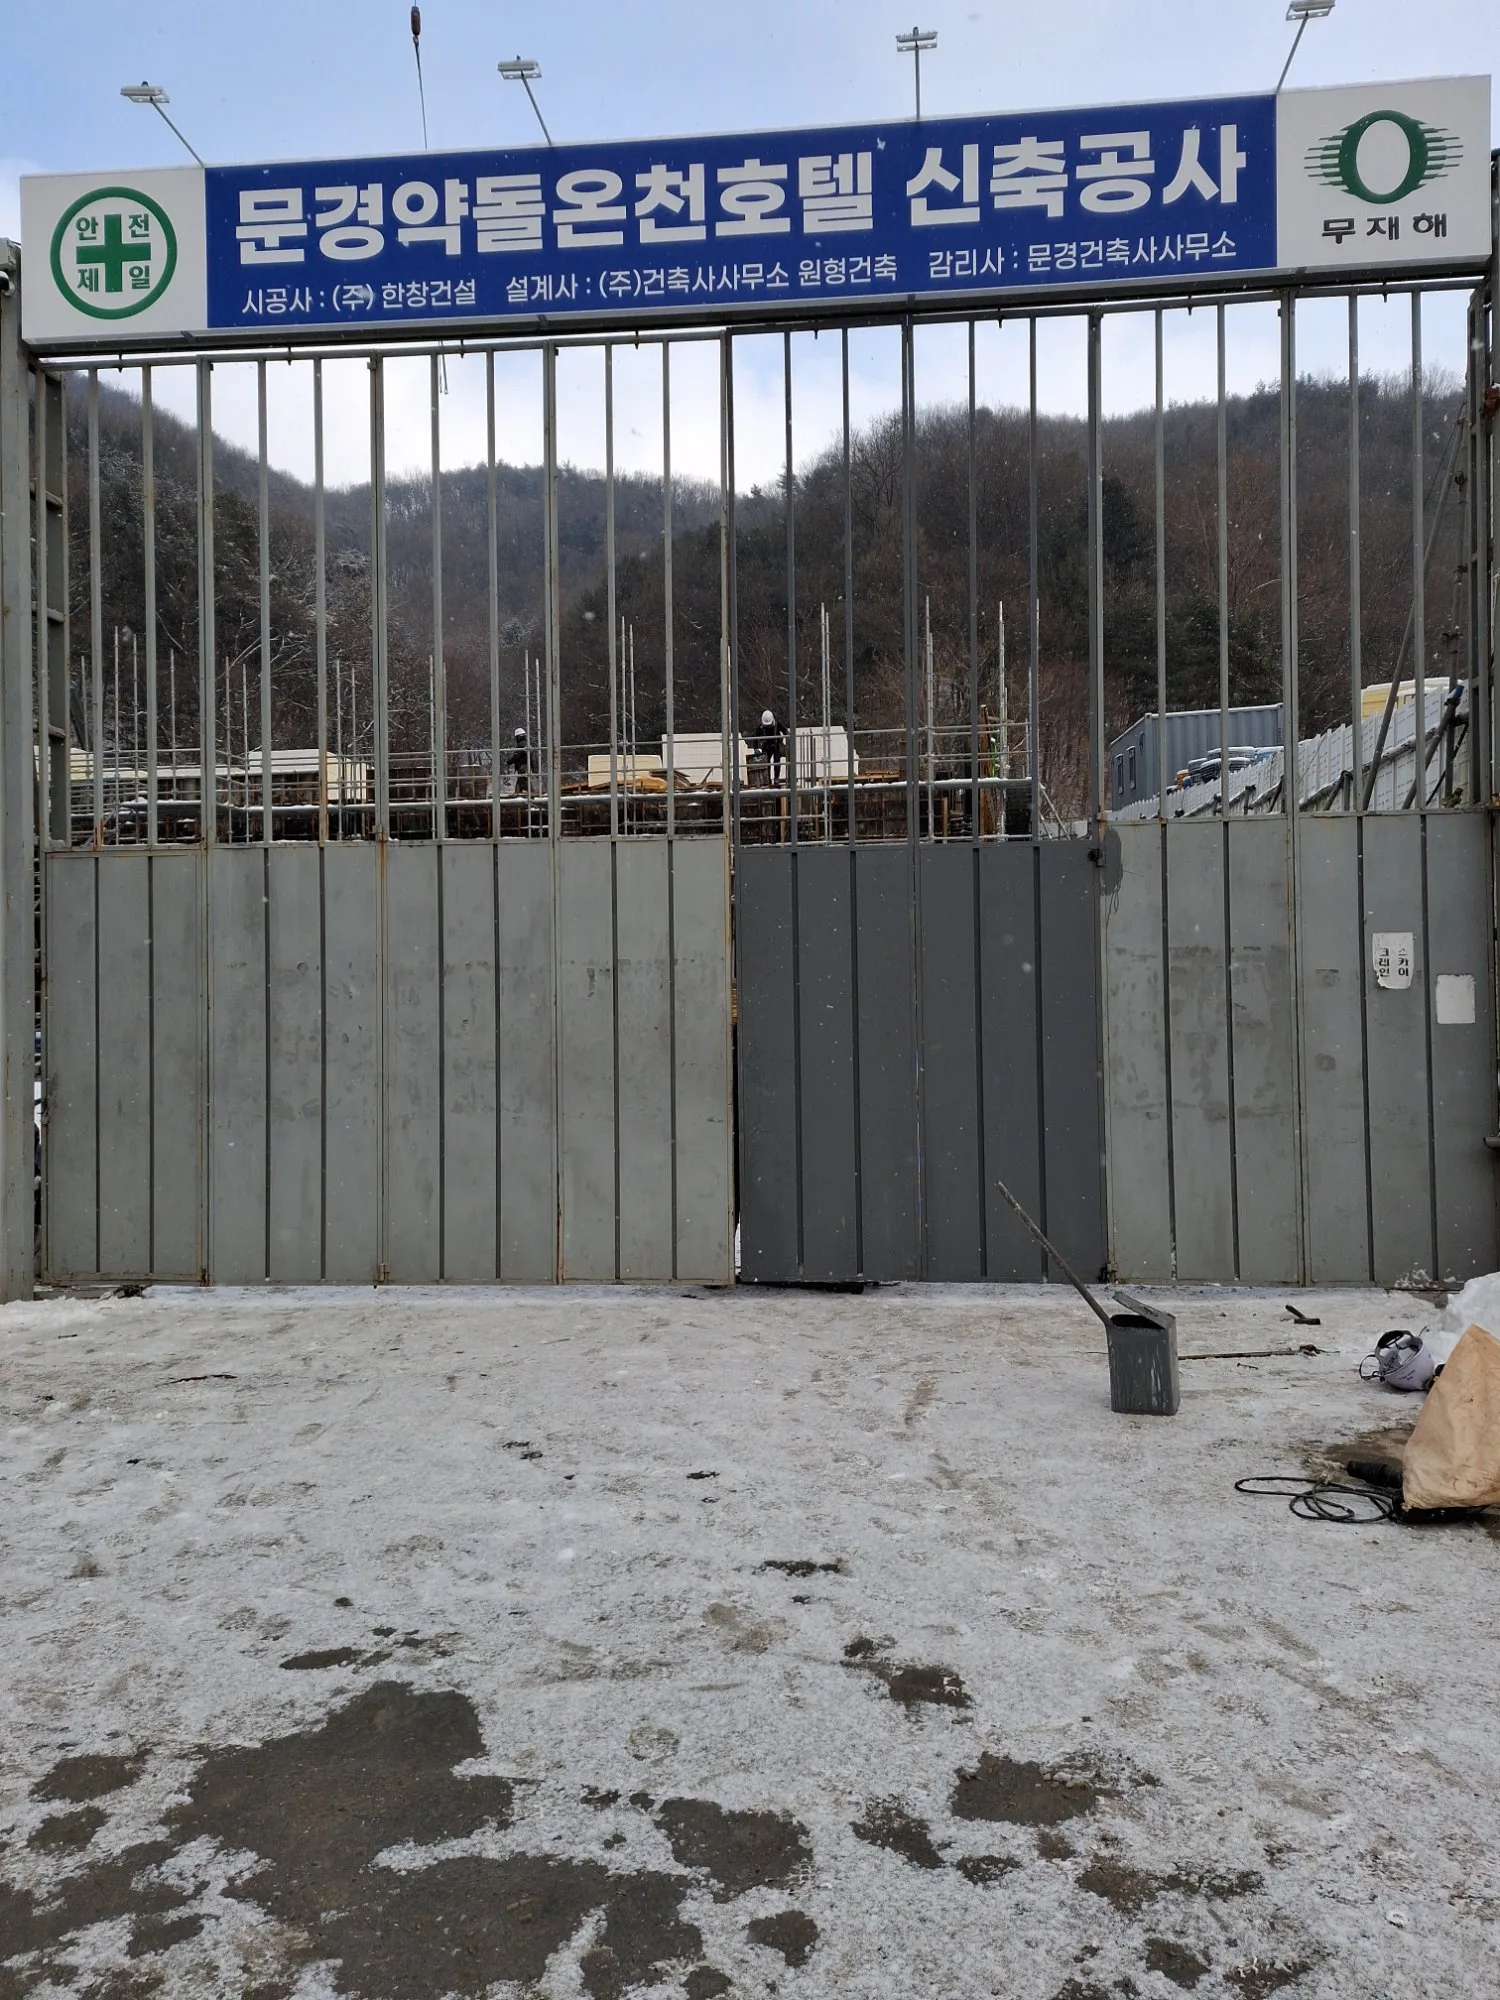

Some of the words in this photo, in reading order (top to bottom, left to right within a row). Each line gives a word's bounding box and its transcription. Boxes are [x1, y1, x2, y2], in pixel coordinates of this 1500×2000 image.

[235, 151, 874, 266] 문경약돌온천호텔
[906, 124, 1247, 227] 신축공사
[1321, 212, 1447, 245] 무재해
[1027, 231, 1238, 273] 문경건축사사무소
[798, 253, 898, 287] 원형건축
[381, 278, 476, 309] 한창건설
